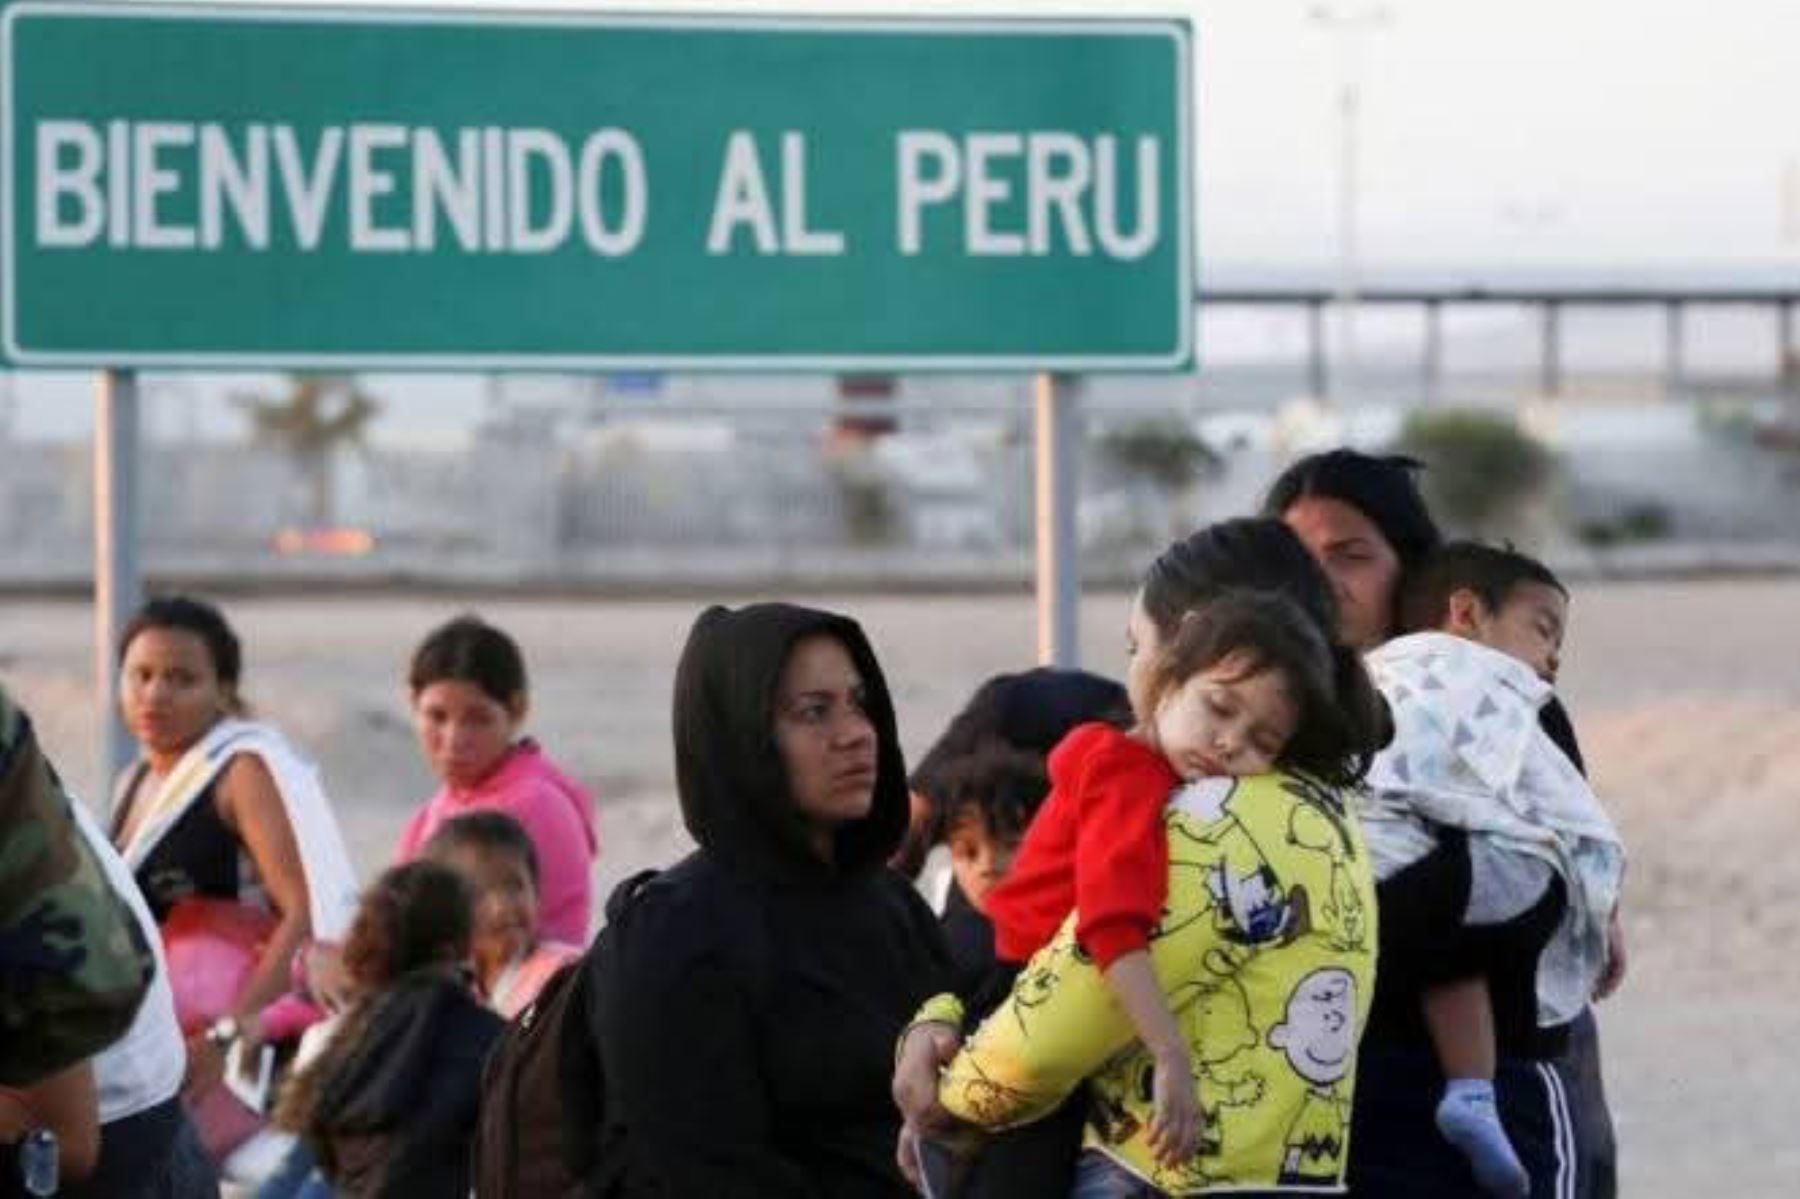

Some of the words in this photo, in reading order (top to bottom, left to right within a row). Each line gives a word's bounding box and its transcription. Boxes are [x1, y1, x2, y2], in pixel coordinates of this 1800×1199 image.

[36, 120, 647, 257] BIENVENIDO
[706, 130, 845, 255] AL
[896, 131, 1160, 259] PERU
